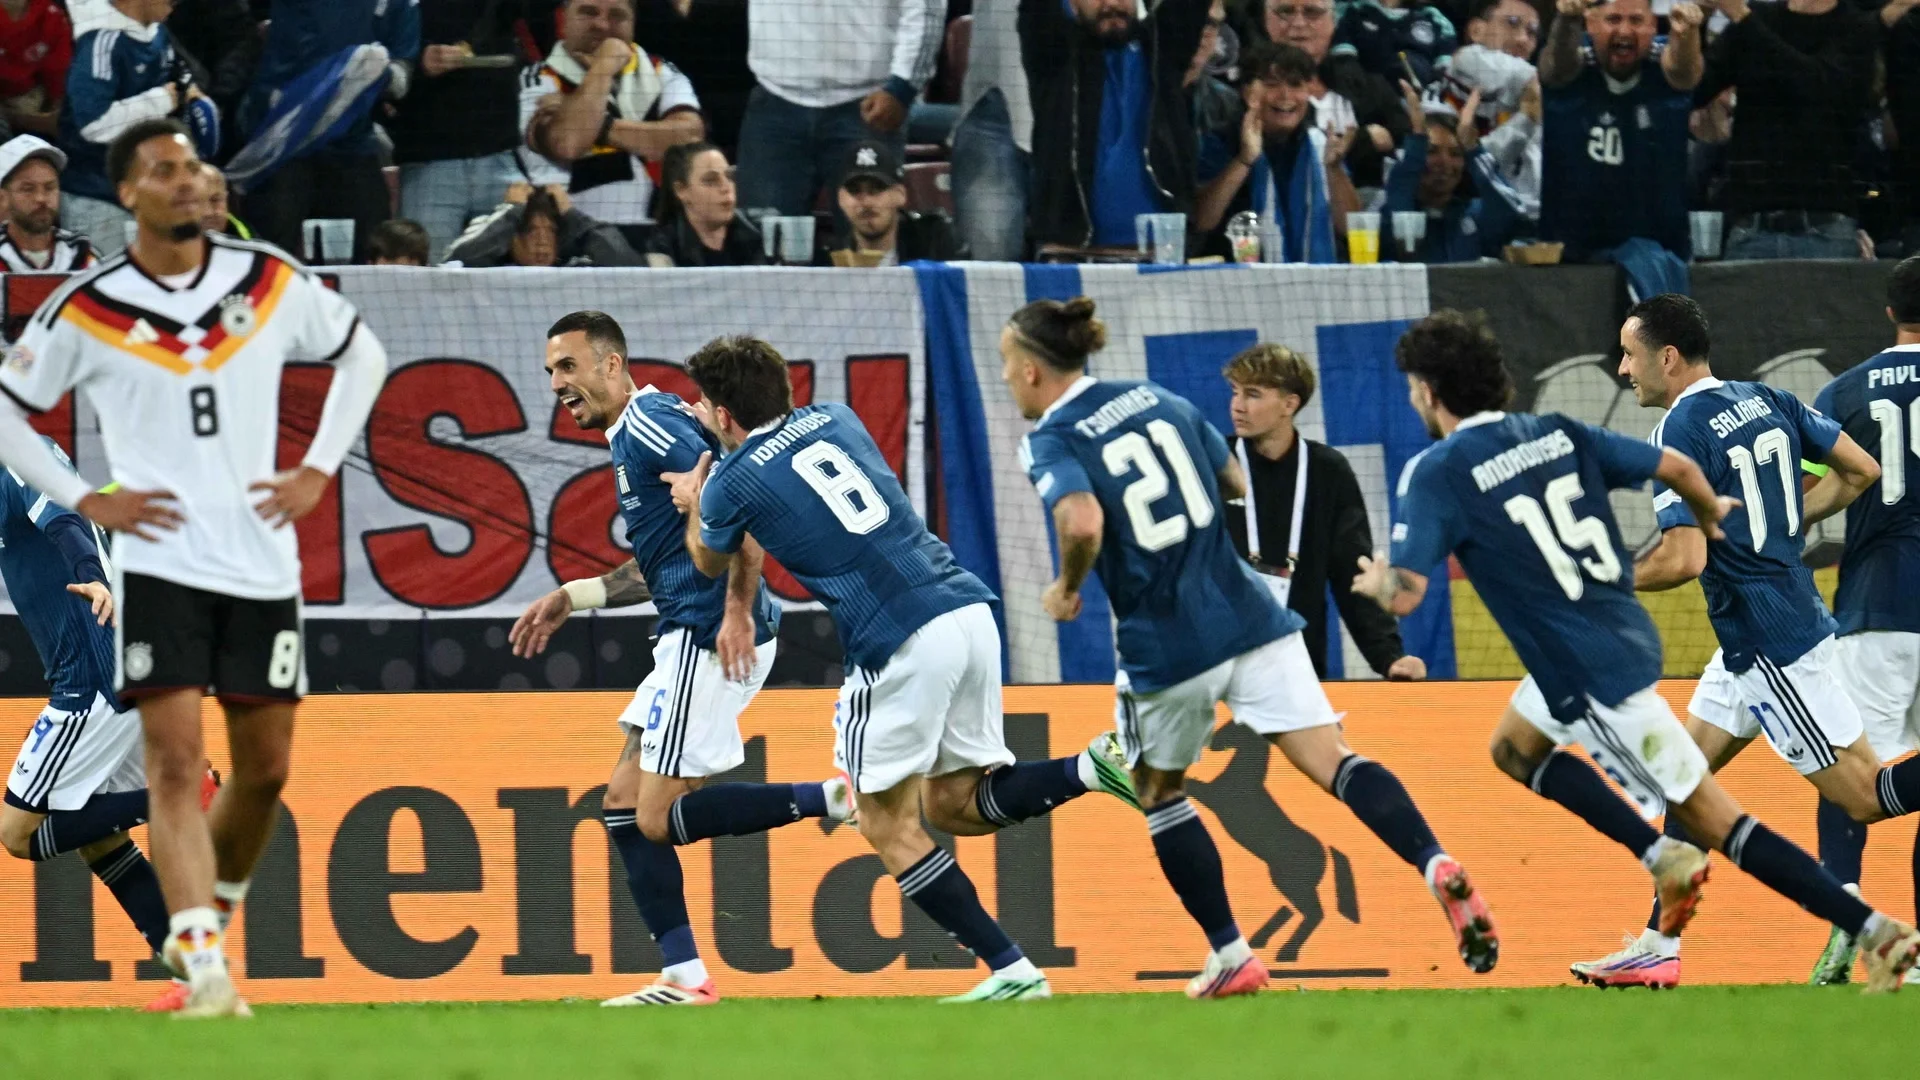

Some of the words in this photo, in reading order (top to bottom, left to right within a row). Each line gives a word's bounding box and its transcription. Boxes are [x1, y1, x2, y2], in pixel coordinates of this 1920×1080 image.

[1588, 126, 1624, 165] 20
[1868, 365, 1920, 389] PAVL
[189, 385, 219, 437] 8
[749, 411, 832, 467] IOANNIDIS
[791, 440, 891, 535] 8
[1102, 419, 1215, 552] 21
[1726, 428, 1799, 553] 17
[1503, 472, 1623, 601] 15
[268, 629, 300, 689] 8
[31, 715, 54, 753] 9
[646, 689, 667, 730] 6
